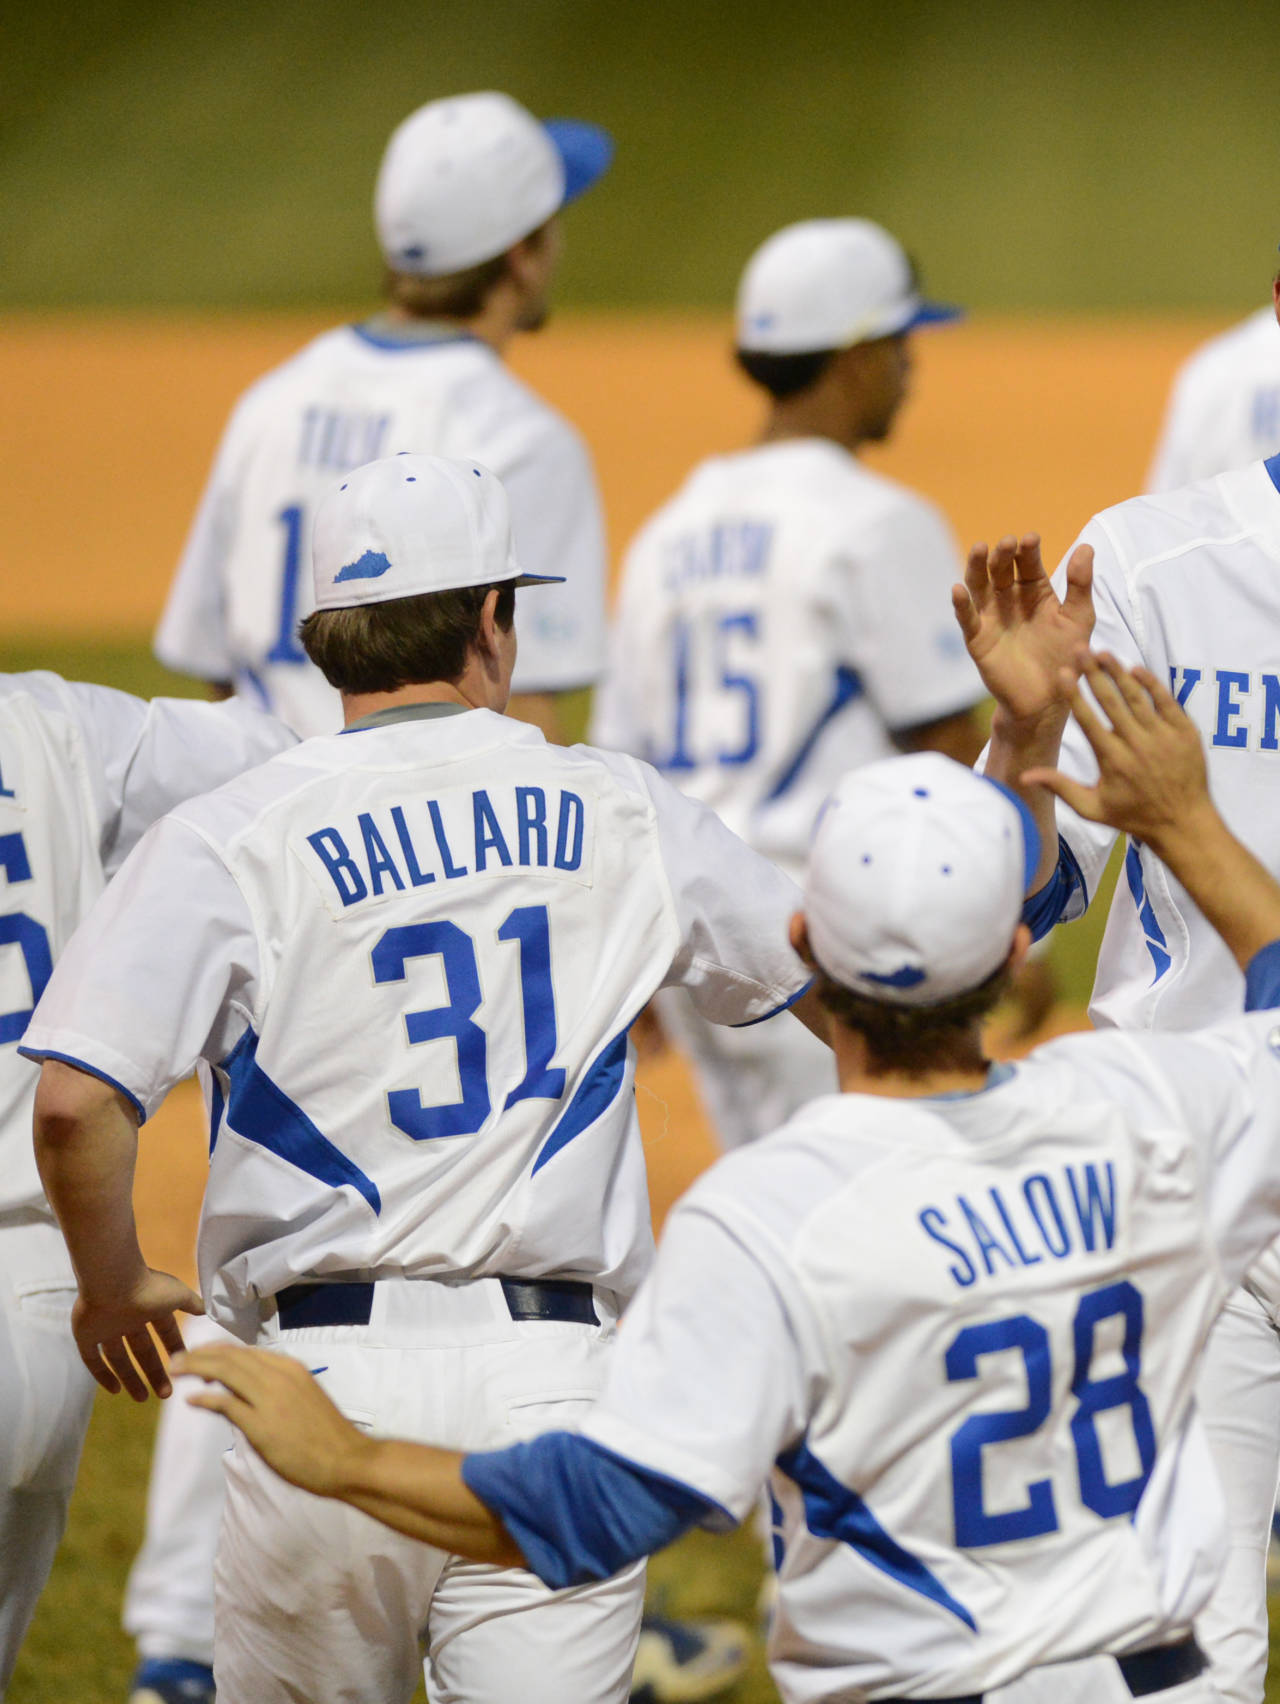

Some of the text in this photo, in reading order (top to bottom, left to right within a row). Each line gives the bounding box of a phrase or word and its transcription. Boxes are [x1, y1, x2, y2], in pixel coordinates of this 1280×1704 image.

[652, 611, 760, 772] 15
[307, 786, 584, 910] BALLARD
[371, 904, 569, 1142] 31
[918, 1161, 1117, 1288] SALOW
[945, 1280, 1157, 1548] 28
